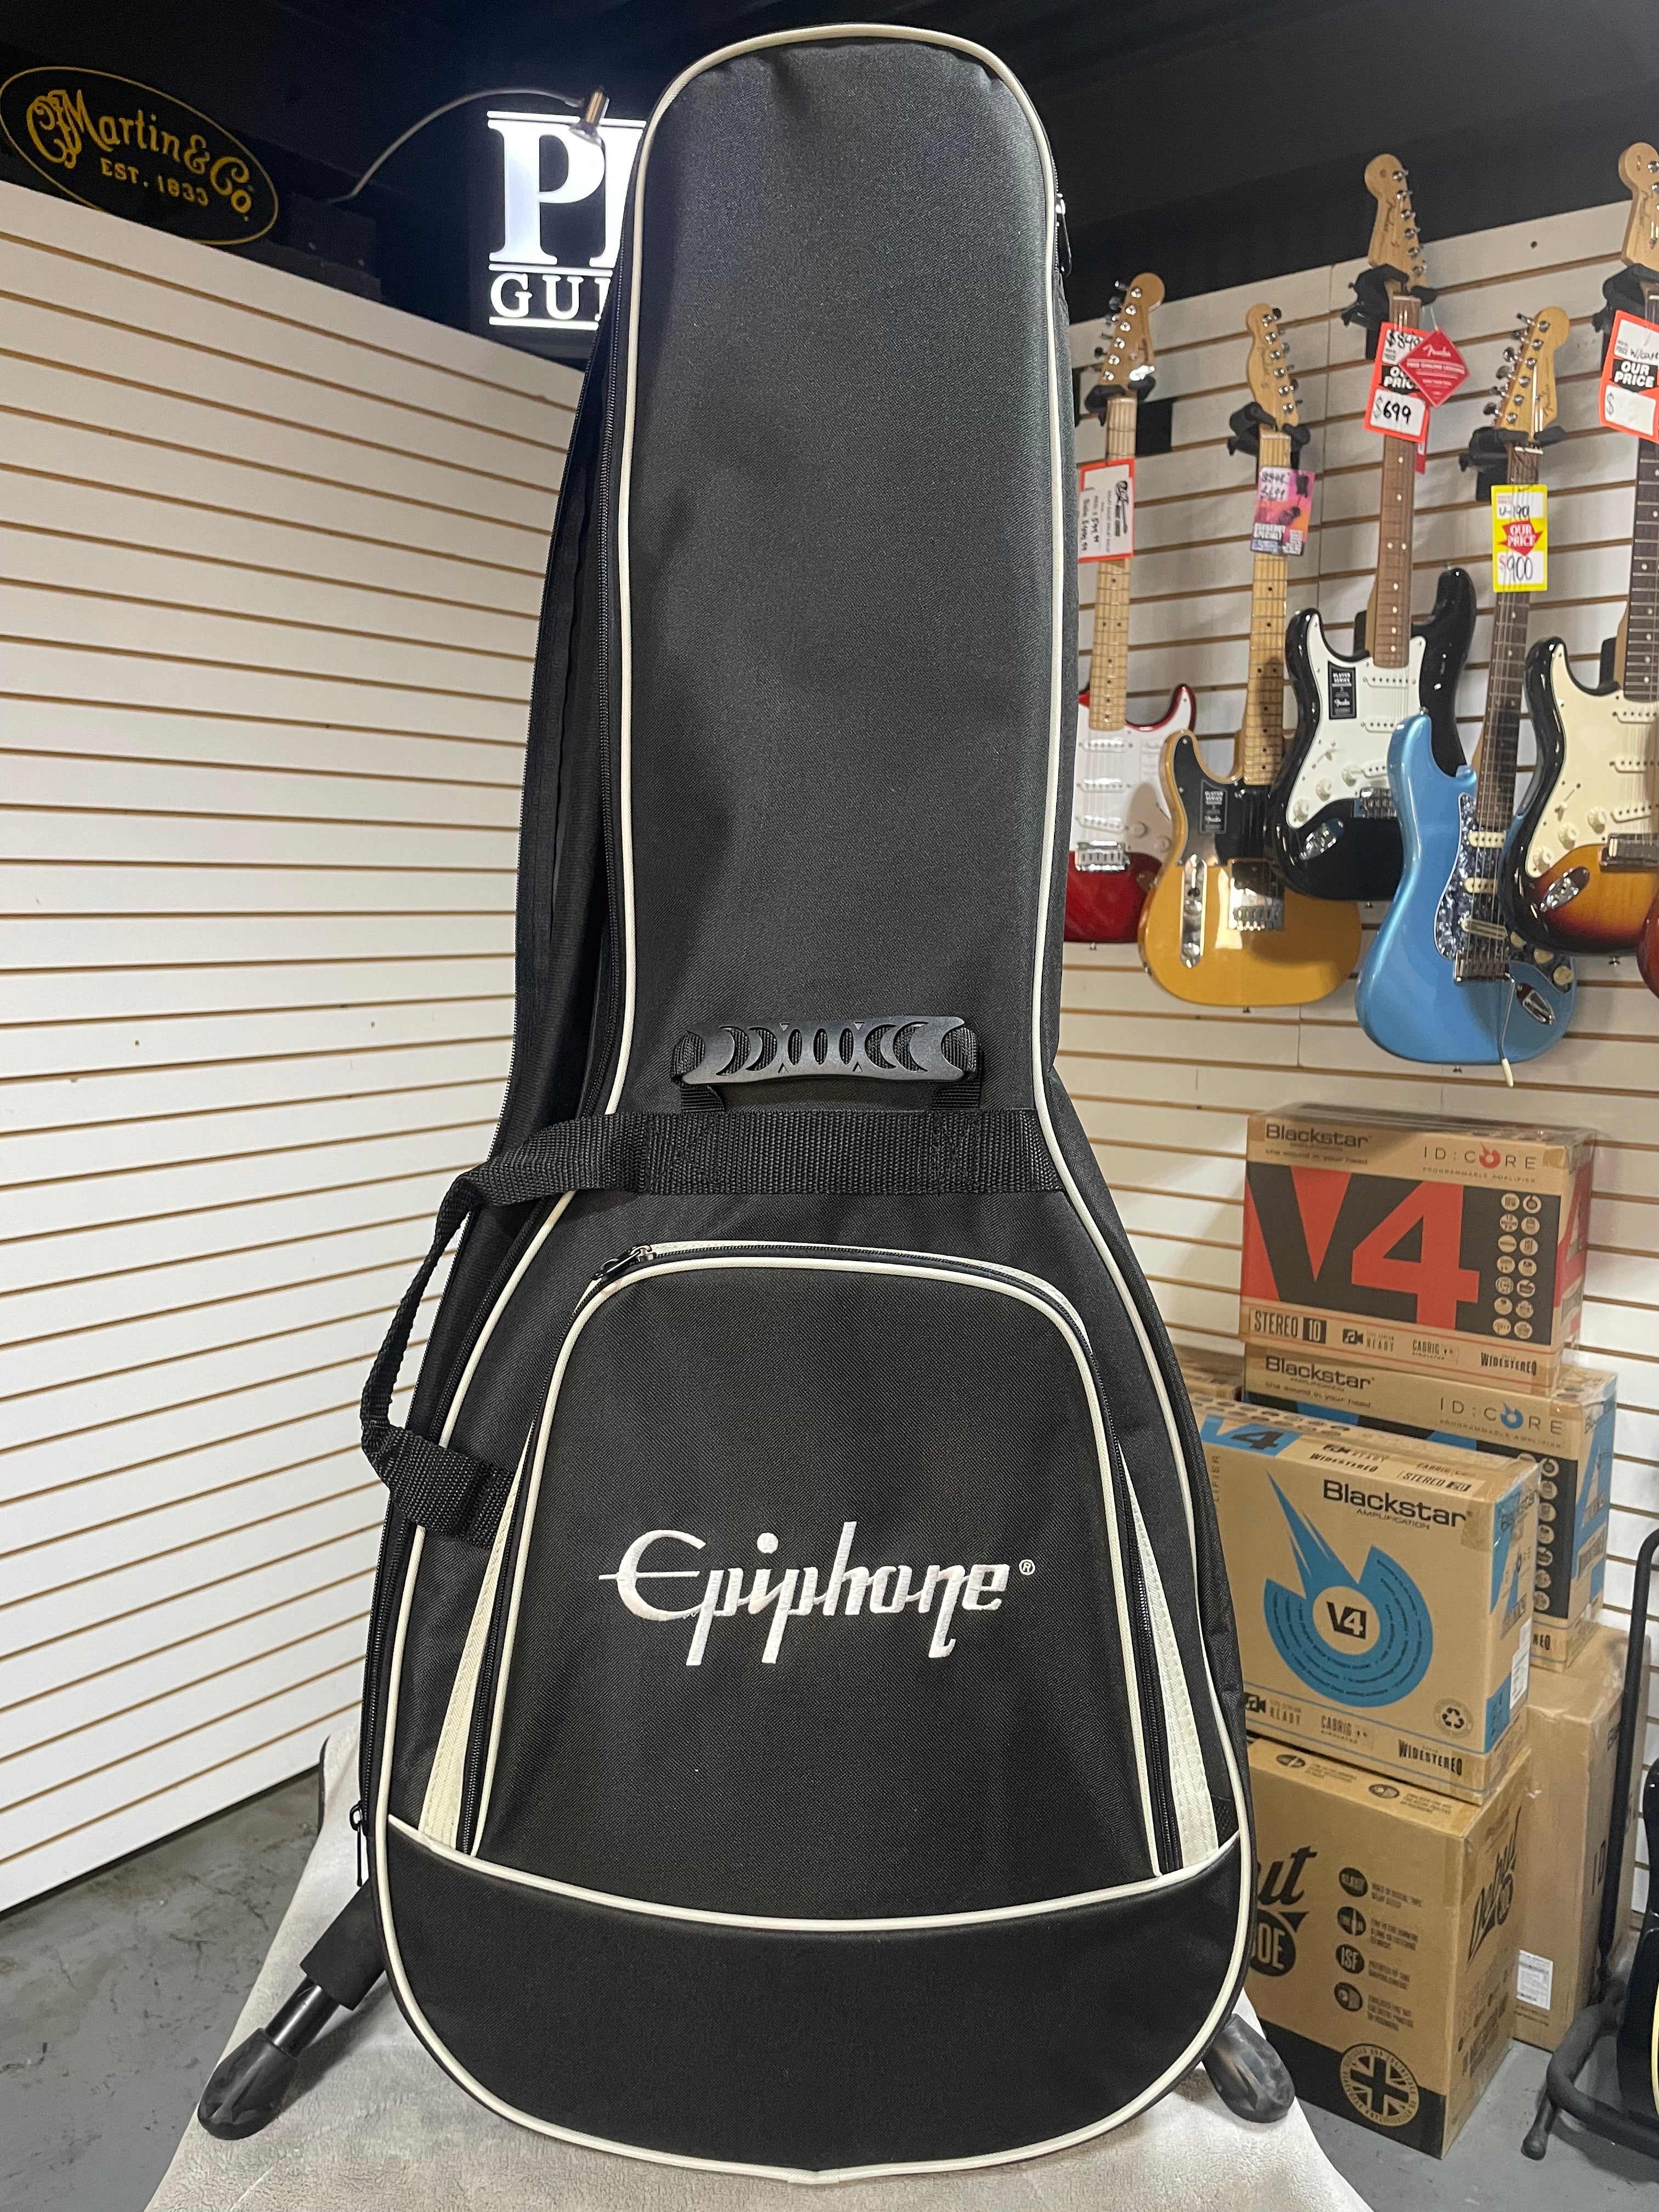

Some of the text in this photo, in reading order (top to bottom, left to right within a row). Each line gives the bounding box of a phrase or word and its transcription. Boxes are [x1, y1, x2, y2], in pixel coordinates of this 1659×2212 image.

[1614, 371, 1655, 387] PRICE
[1621, 360, 1650, 375] OUR
[1384, 376, 1419, 390] PRIC
[1508, 535, 1536, 547] PRICE
[1509, 524, 1532, 536] OUR
[1266, 1124, 1368, 1149] Blackstar
[1254, 1310, 1299, 1339] STEREO
[1266, 1355, 1371, 1389] Blackstar
[1481, 1352, 1537, 1376] WIDESTEREO
[1323, 1479, 1466, 1527] Blackstar
[1356, 1508, 1430, 1530] AMPLIFICATION
[599, 1521, 1011, 1666] Epiphone
[1327, 1601, 1367, 1640] V4
[1398, 1739, 1463, 1777] WIDESTEREO
[1340, 1946, 1359, 1971] ISF
